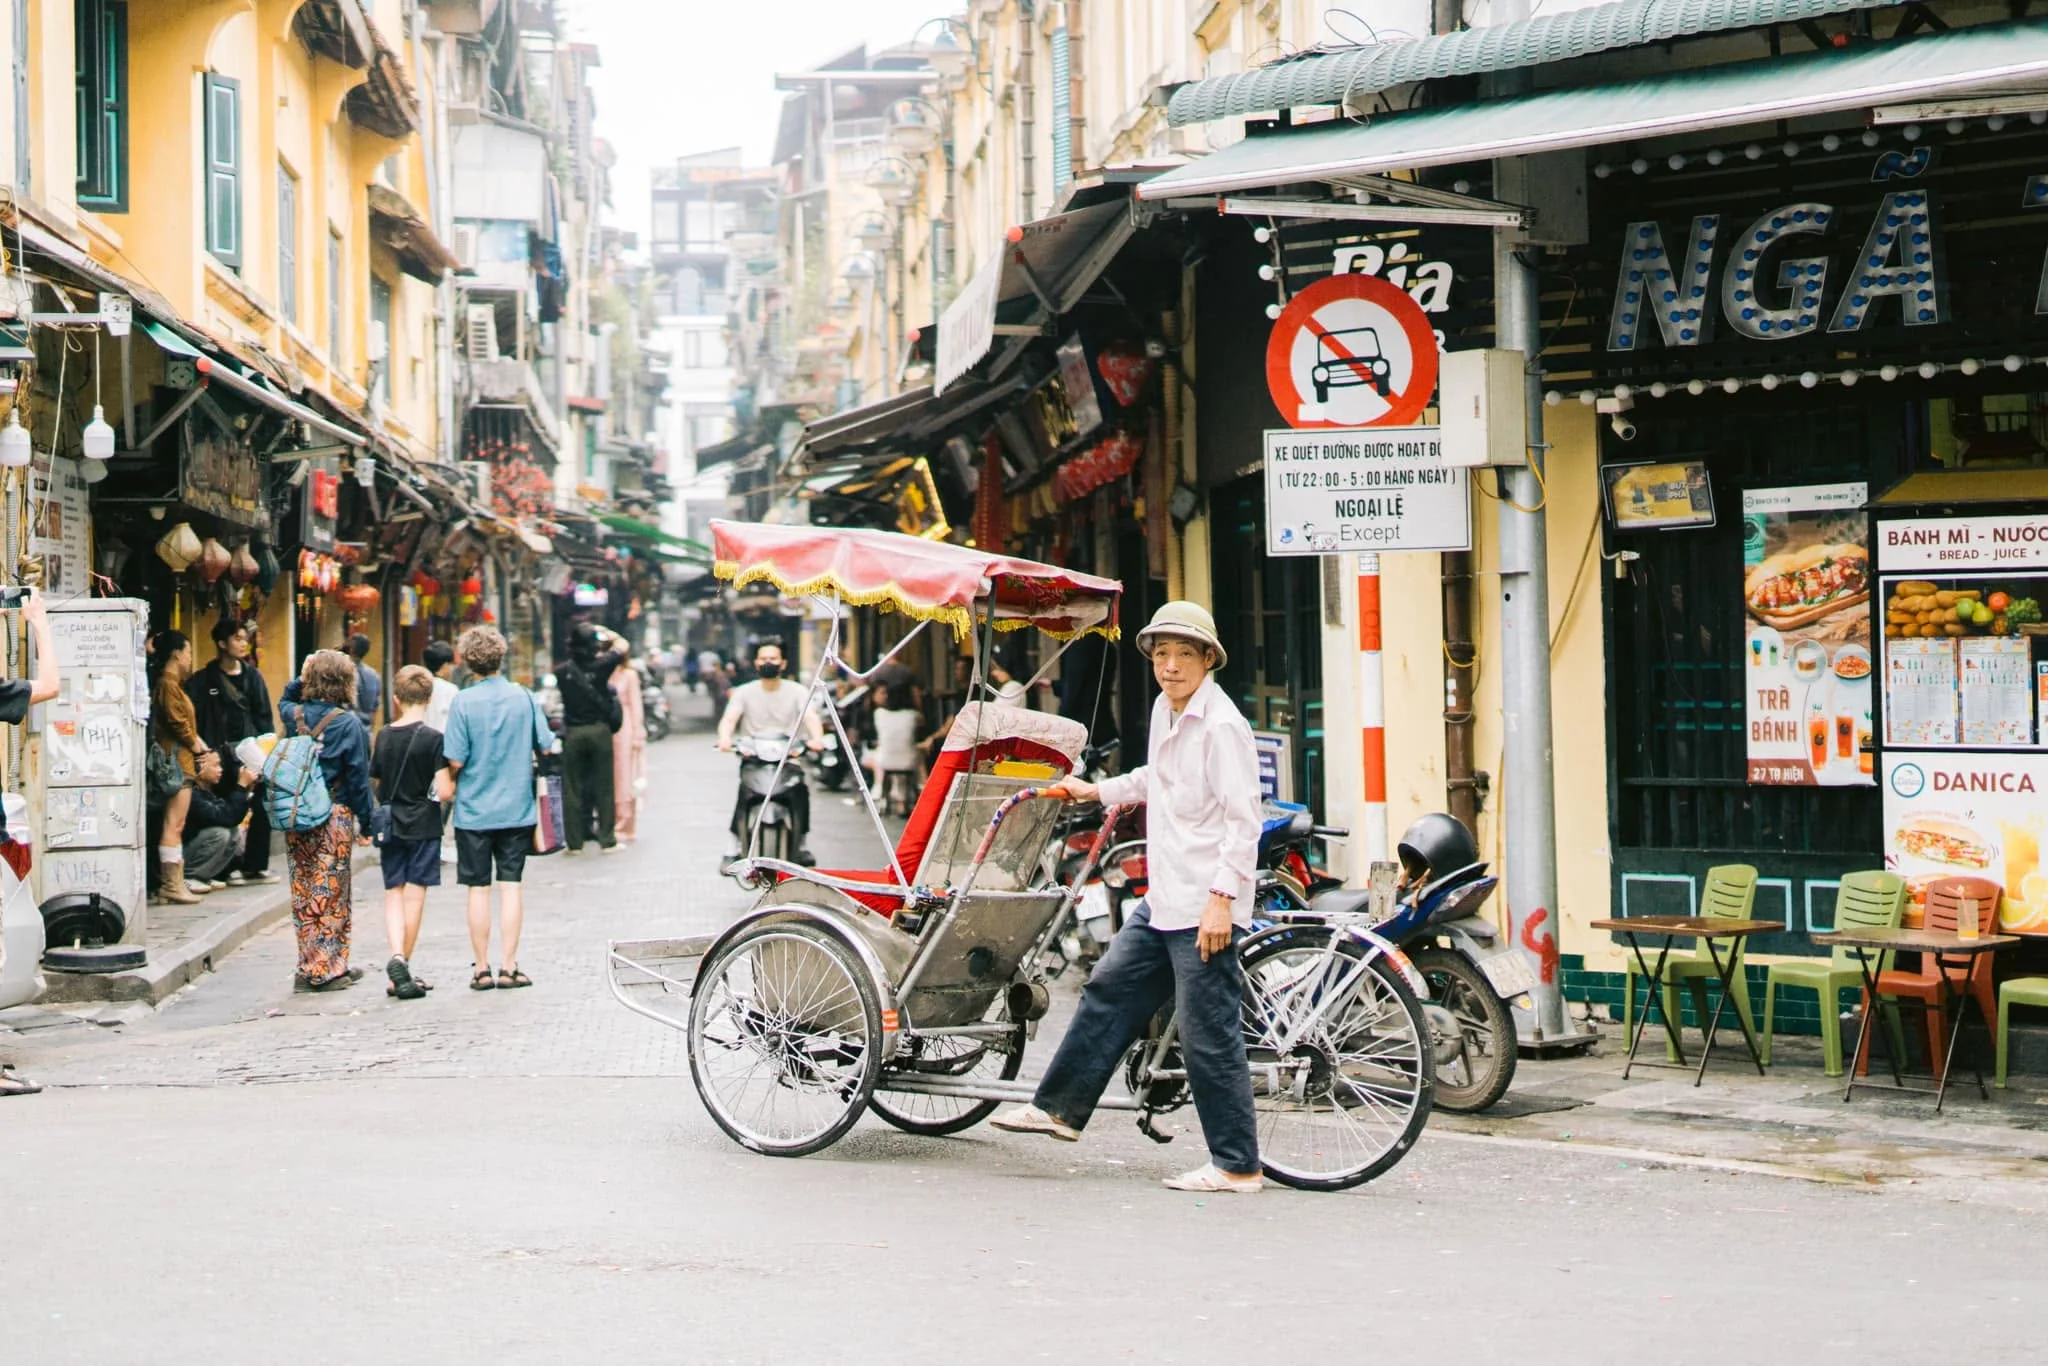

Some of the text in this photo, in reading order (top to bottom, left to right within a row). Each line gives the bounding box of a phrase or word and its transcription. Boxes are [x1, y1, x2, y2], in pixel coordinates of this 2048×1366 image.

[1606, 146, 1938, 351] NGÃ
[1275, 446, 1288, 461] XE
[1292, 442, 1319, 460] QUÉT
[1323, 440, 1361, 459] ĐƯỜNG
[1364, 442, 1394, 461] ĐƯỢC
[1384, 466, 1414, 485] HÀNG
[1335, 493, 1404, 520] NGOẠI LỆ
[1340, 524, 1401, 544] Except
[1887, 526, 1941, 546] BÁNH
[1947, 524, 1971, 545] MÌ
[1939, 550, 1980, 561] BREAD
[1993, 548, 2028, 561] JUICE
[1756, 684, 1789, 711] TRÀ
[1751, 715, 1798, 742] BÁNH
[1753, 767, 1766, 781] 27
[1933, 771, 2036, 793] DANICA
